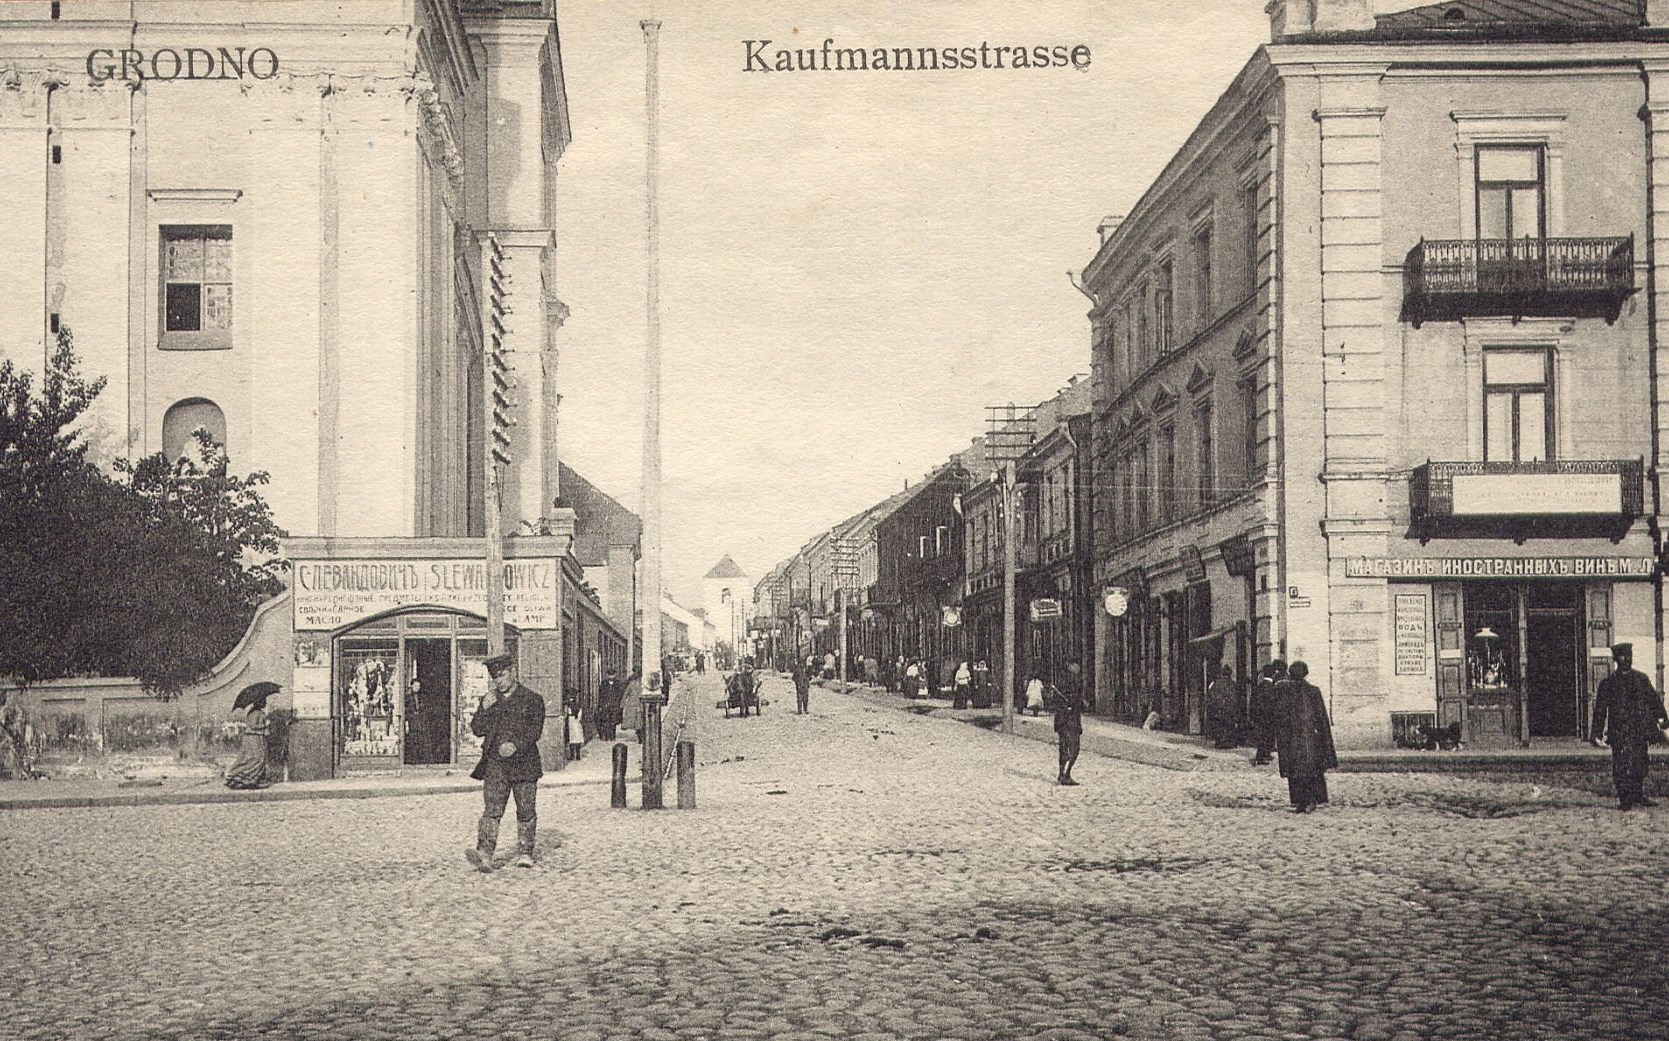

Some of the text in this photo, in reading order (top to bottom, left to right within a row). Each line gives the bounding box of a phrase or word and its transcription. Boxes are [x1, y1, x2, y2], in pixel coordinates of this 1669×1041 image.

[1348, 558, 1434, 575] МАГАЗИНЪ
[1442, 558, 1568, 575] ИНОСТРАННЫХЪ
[1575, 558, 1615, 574] ВИНЪ
